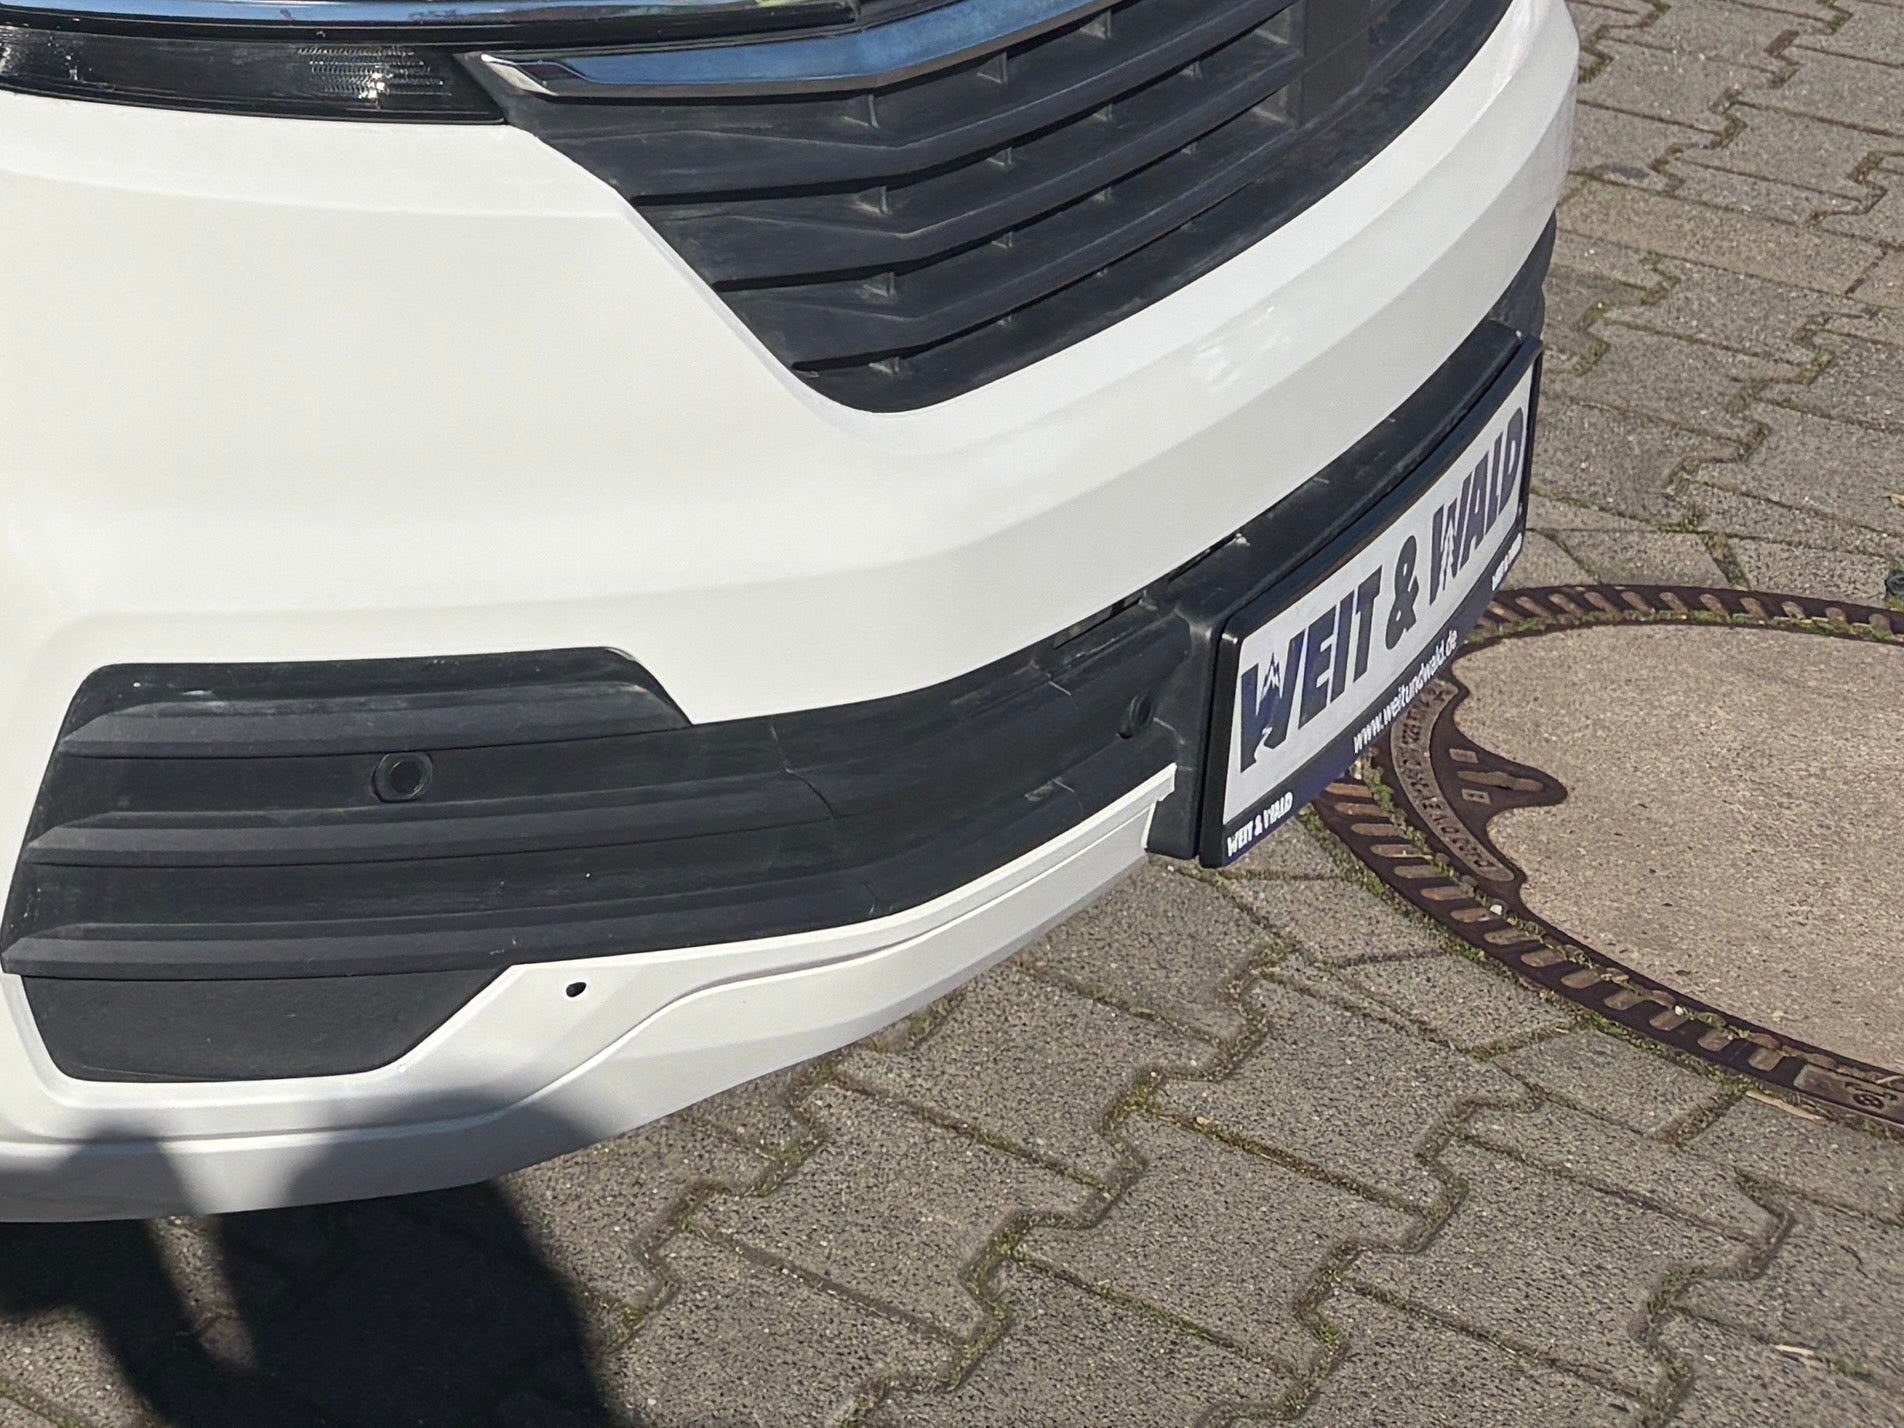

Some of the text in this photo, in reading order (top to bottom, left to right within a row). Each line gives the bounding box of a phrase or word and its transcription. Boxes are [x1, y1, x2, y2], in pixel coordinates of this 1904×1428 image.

[1240, 406, 1524, 774] WEIT & WALD
[1353, 630, 1458, 754] www.weitundwald.de
